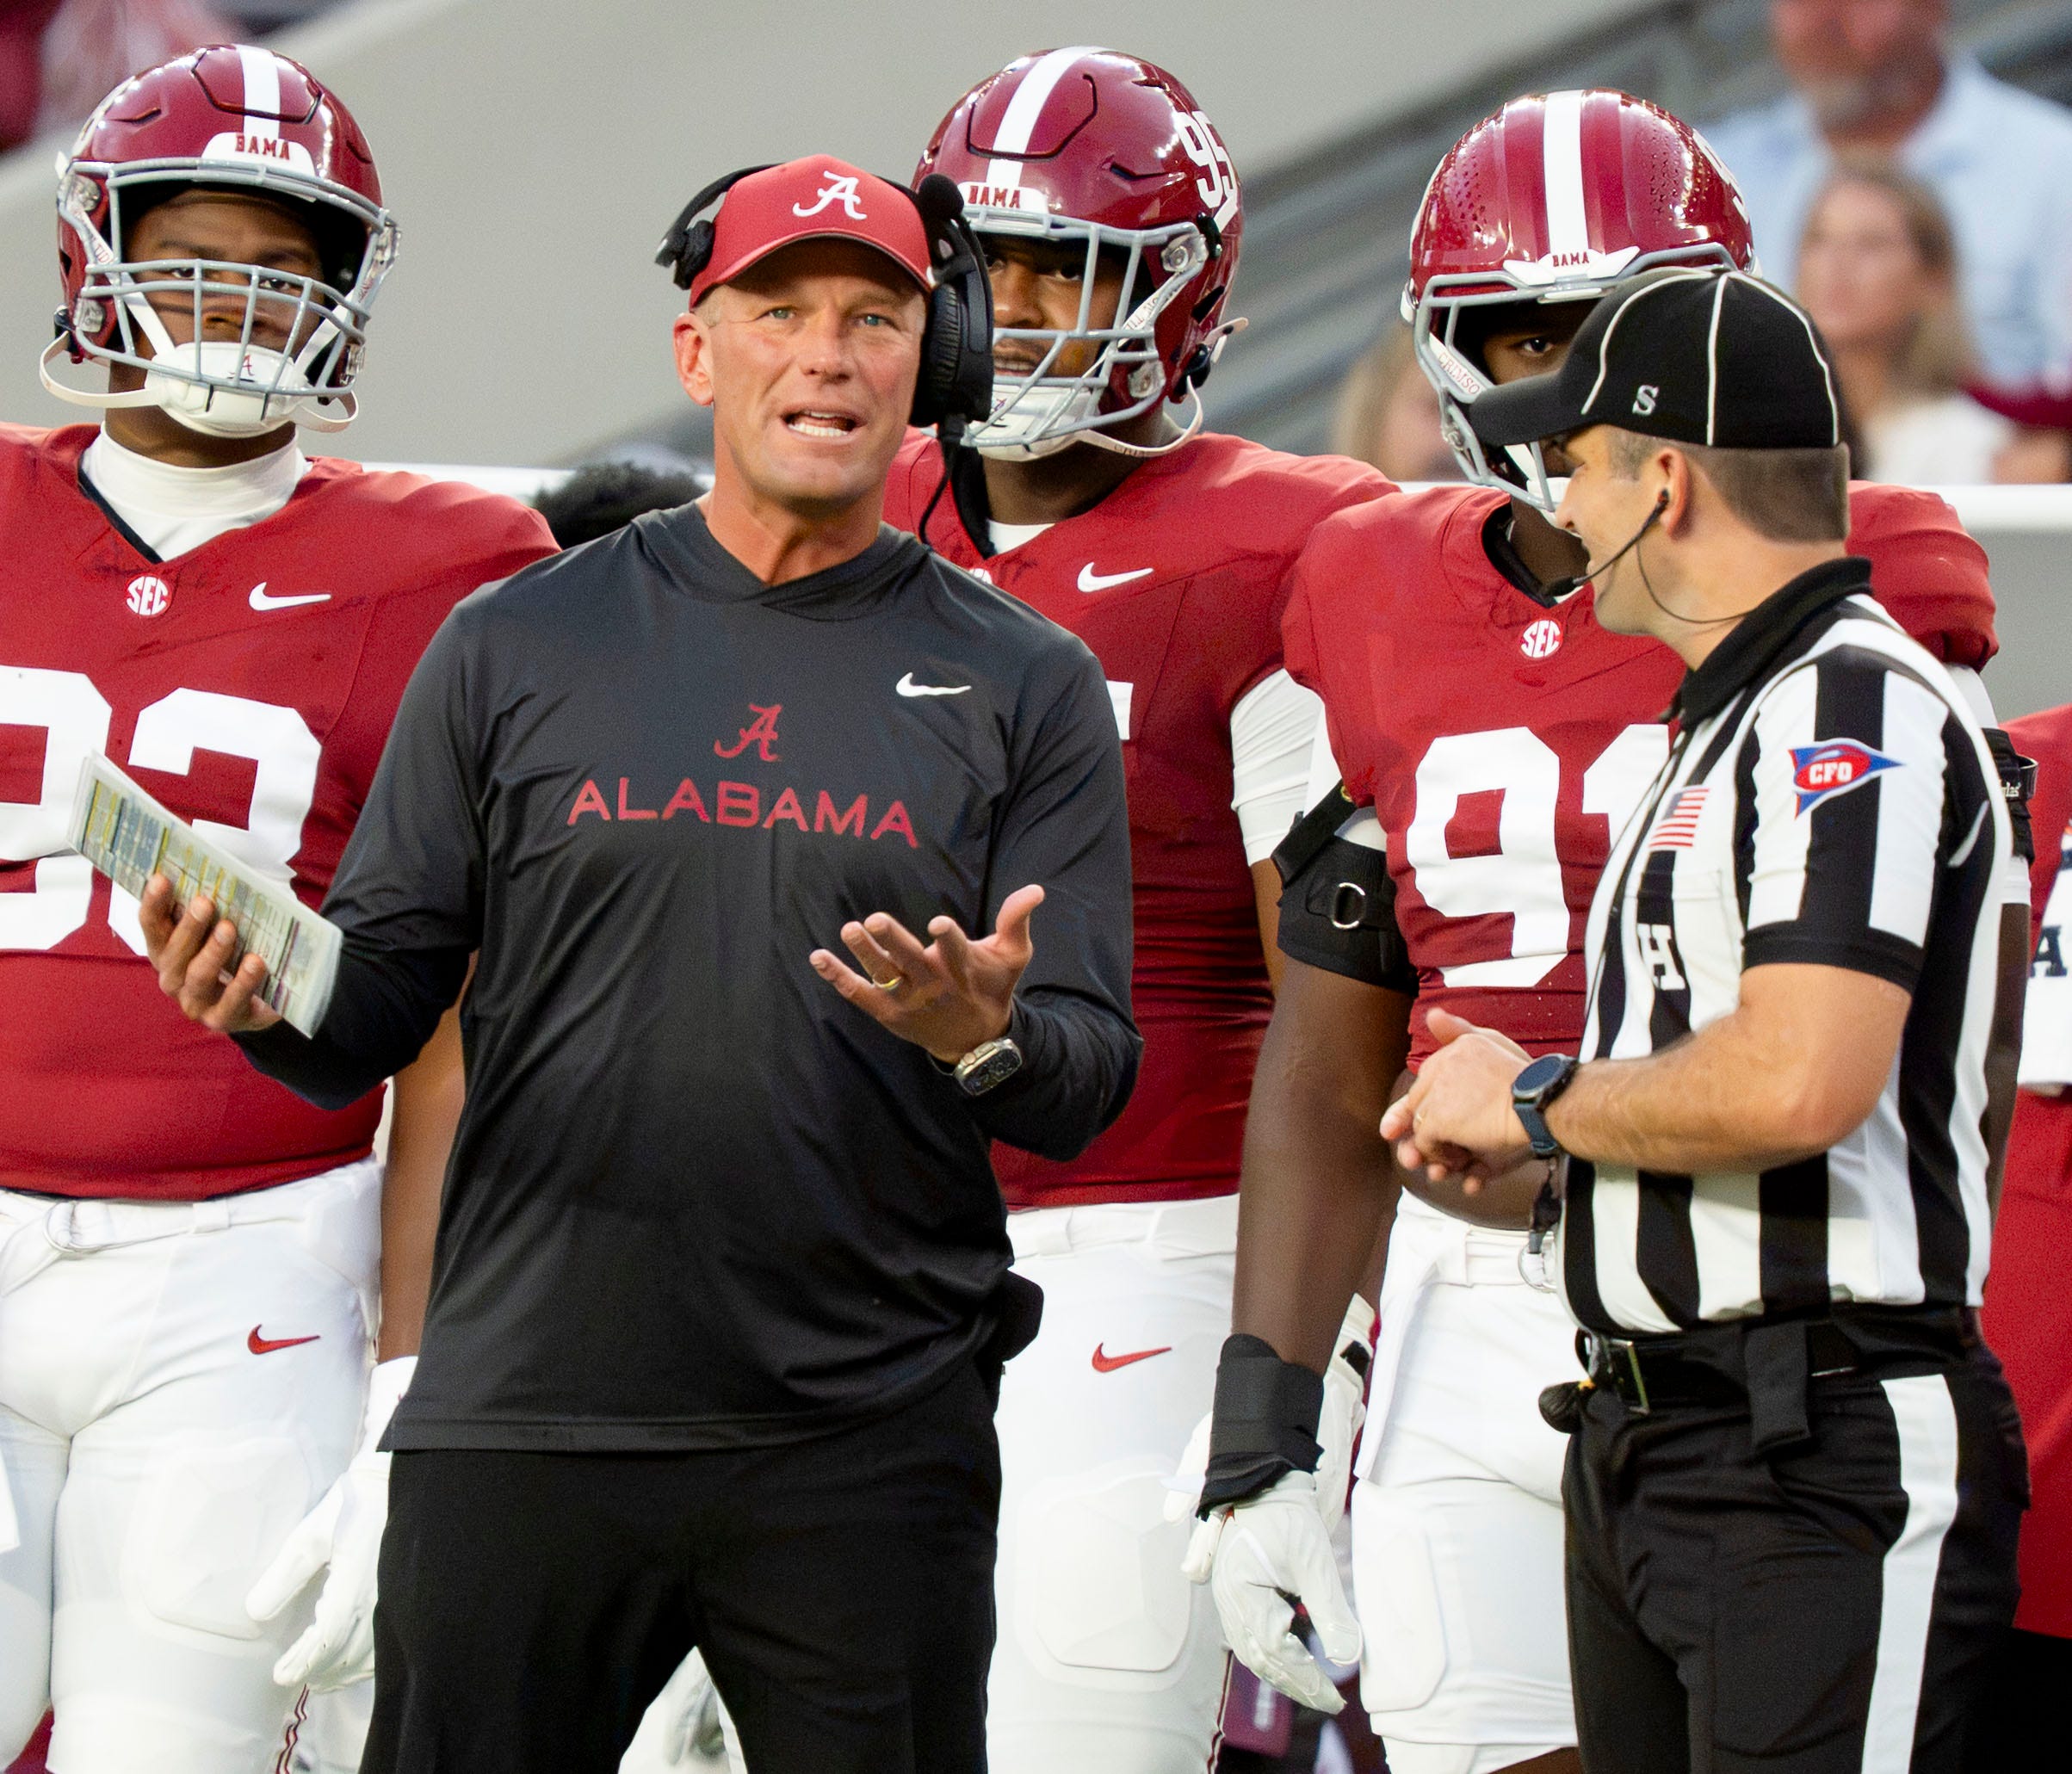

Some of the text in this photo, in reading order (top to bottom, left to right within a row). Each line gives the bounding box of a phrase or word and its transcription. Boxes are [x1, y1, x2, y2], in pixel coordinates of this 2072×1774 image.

[236, 134, 290, 161] BAMA
[792, 170, 867, 219] A
[968, 185, 1021, 209] BAMA
[1552, 251, 1590, 267] BAMA
[1438, 351, 1481, 395] CRIMSO
[1633, 386, 1658, 415] S
[127, 576, 168, 615] SEC
[1521, 621, 1561, 657] SEC
[714, 703, 782, 762] A
[1809, 763, 1852, 785] CFO
[566, 777, 918, 848] ALABAMA
[1637, 924, 1685, 990] H
